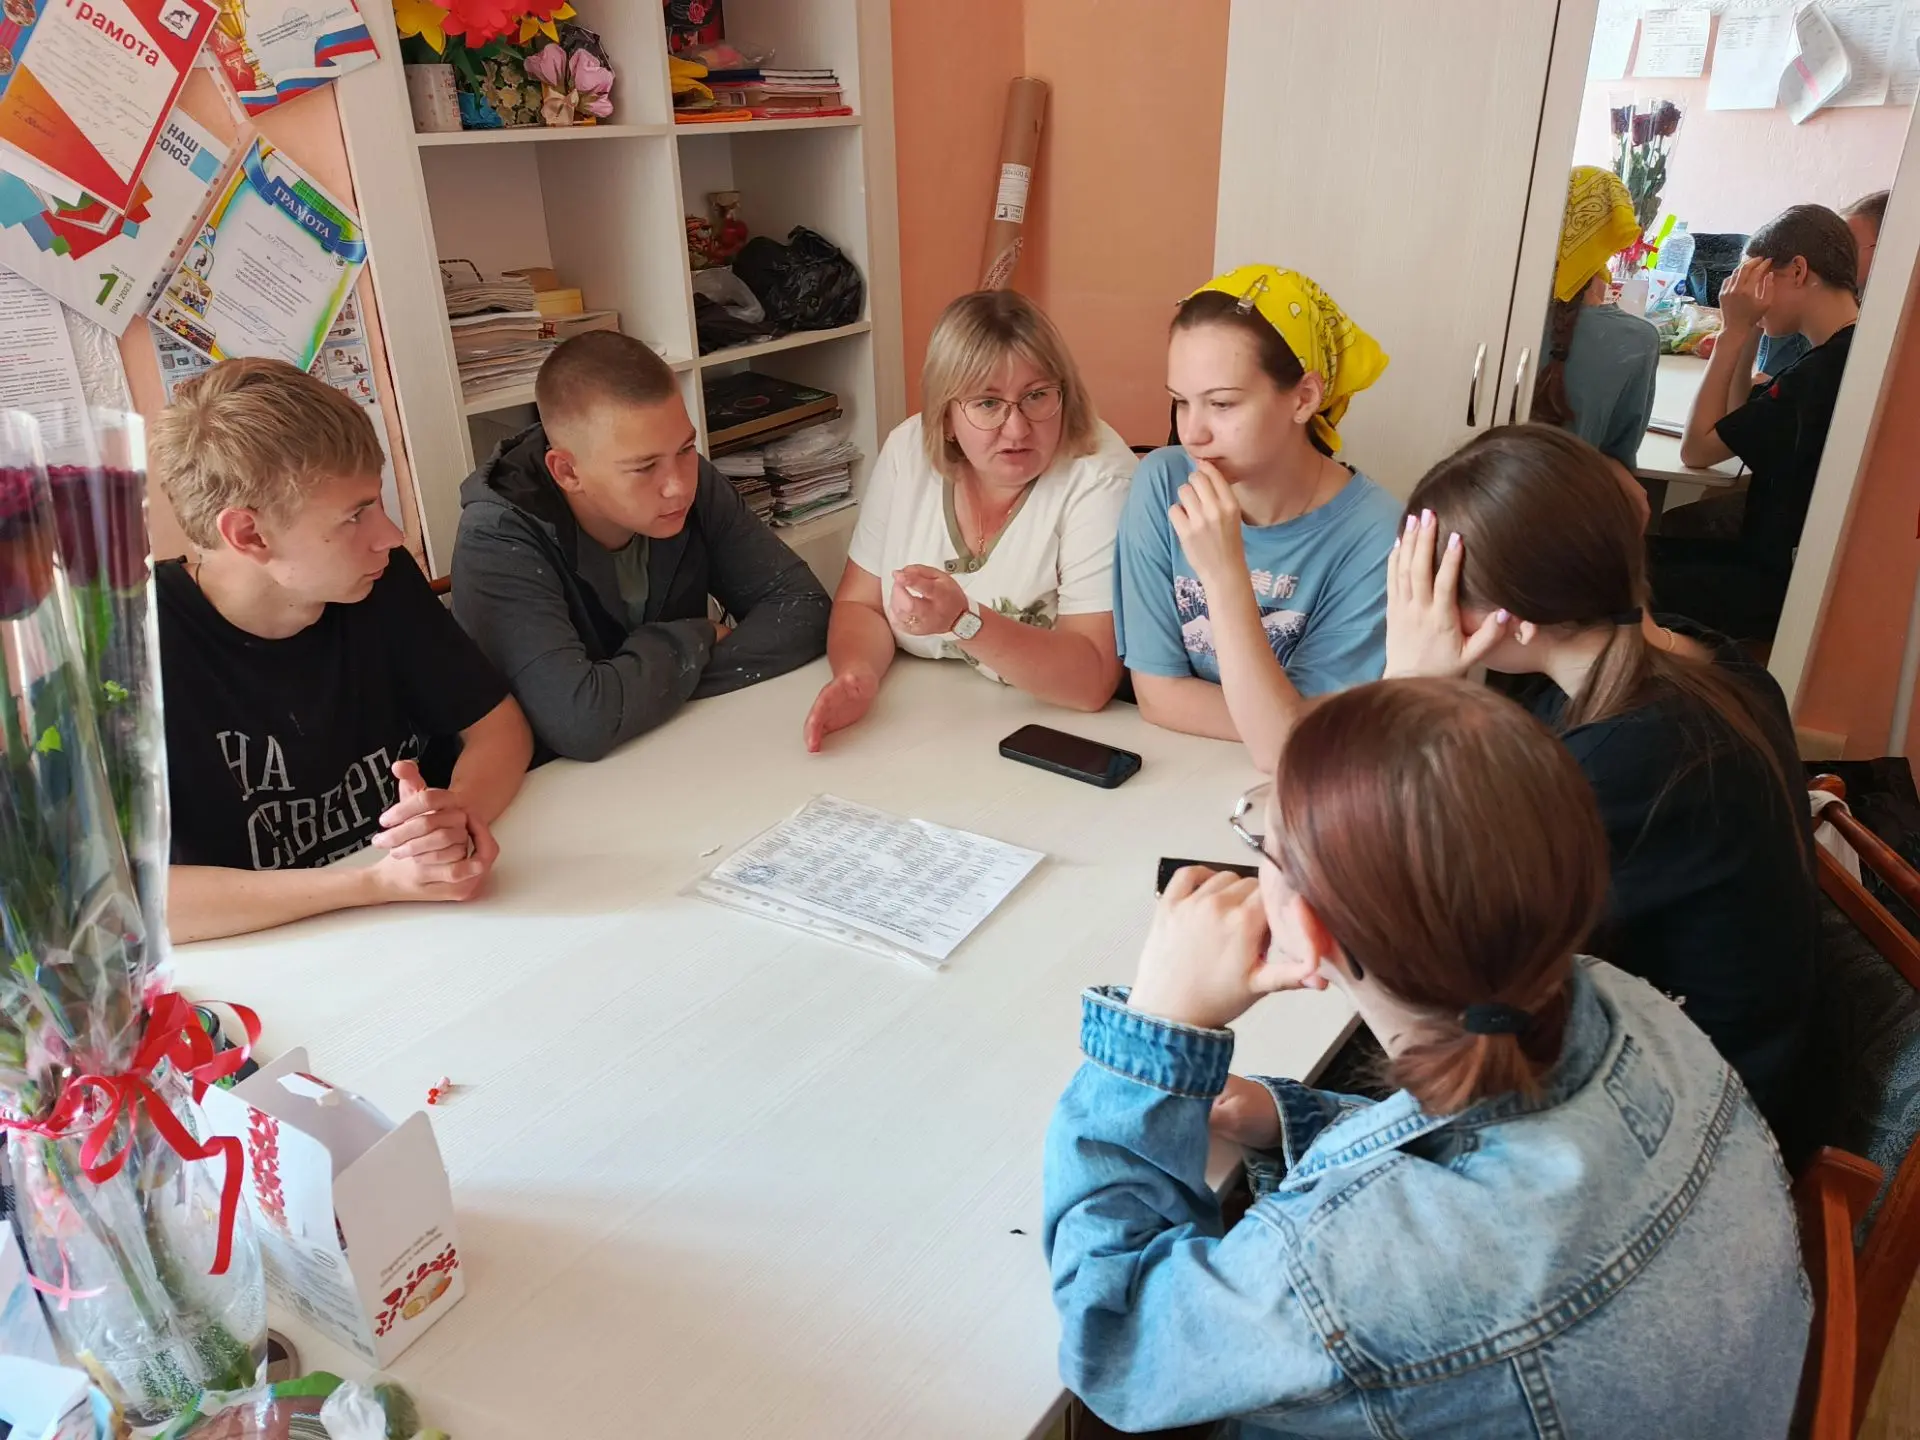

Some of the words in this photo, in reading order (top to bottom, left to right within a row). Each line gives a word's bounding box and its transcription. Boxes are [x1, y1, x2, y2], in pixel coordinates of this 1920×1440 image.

[156, 134, 191, 167] ОЮЗ
[167, 123, 199, 153] НАШ
[274, 186, 331, 238] ГРАМОТА
[95, 273, 119, 306] 1
